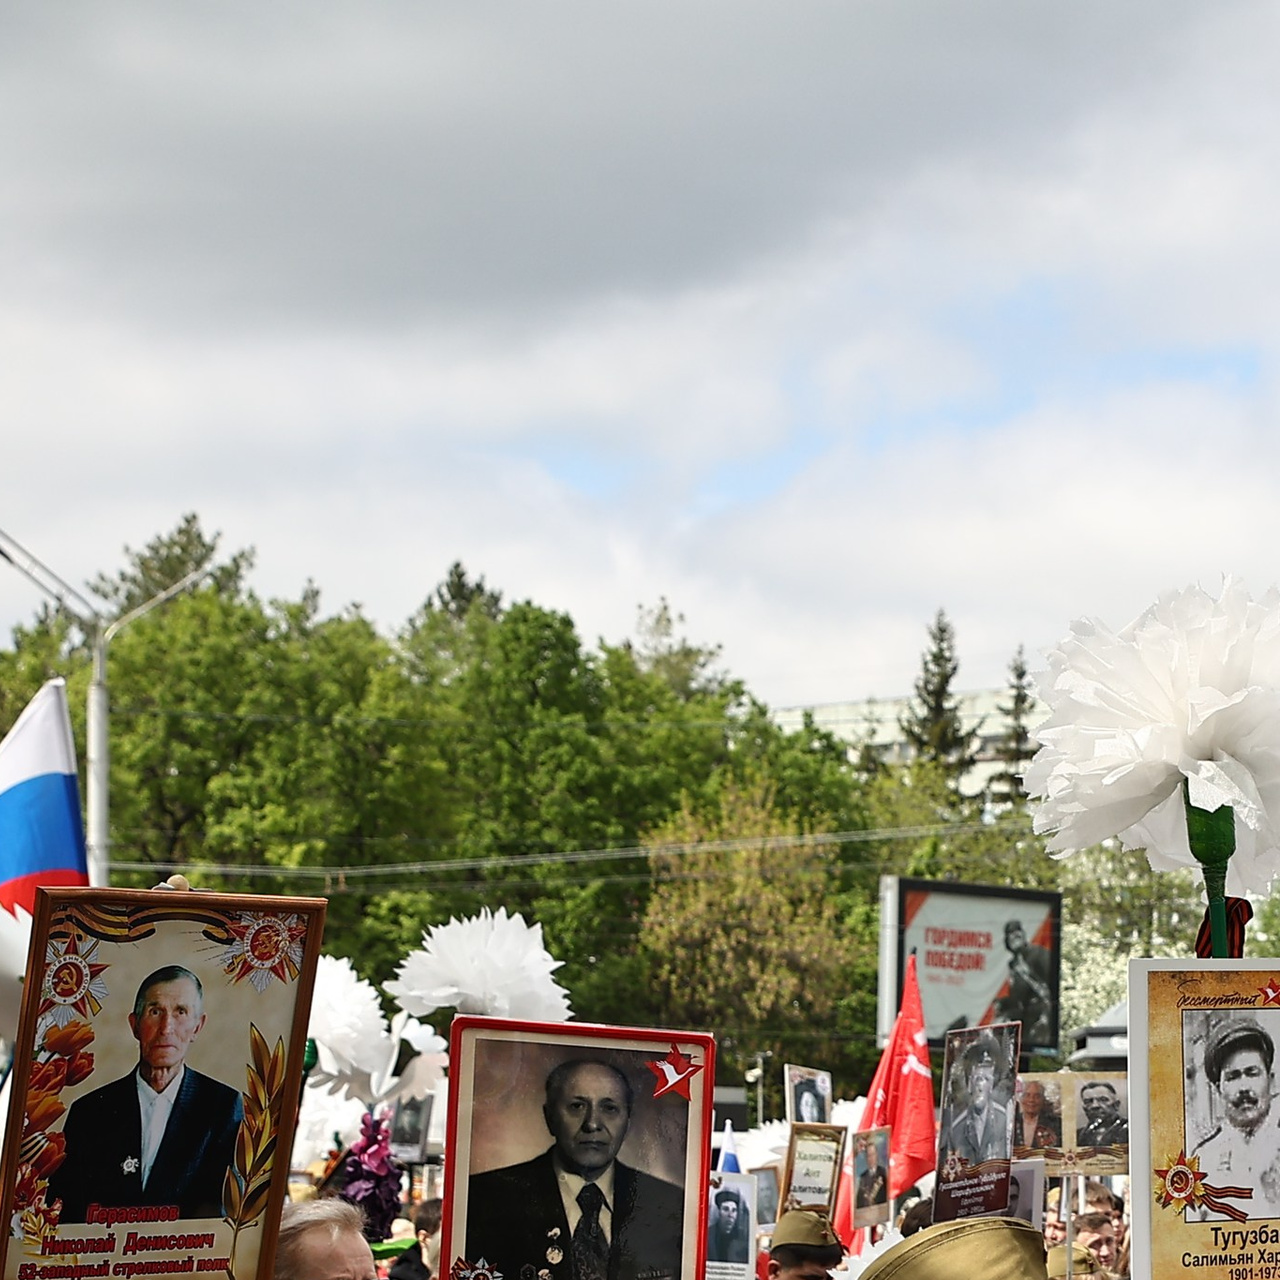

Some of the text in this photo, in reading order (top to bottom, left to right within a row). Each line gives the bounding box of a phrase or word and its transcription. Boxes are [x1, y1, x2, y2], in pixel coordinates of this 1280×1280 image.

[924, 926, 993, 950] ГОРДИМСЯ
[925, 950, 986, 972] ПОБЕДОЙ!
[87, 1203, 180, 1228] Герасимов
[41, 1232, 215, 1256] Николай Денисович
[113, 1255, 194, 1280] стрелковый
[196, 1257, 230, 1273] полк
[1182, 1252, 1254, 1267] Салимьян
